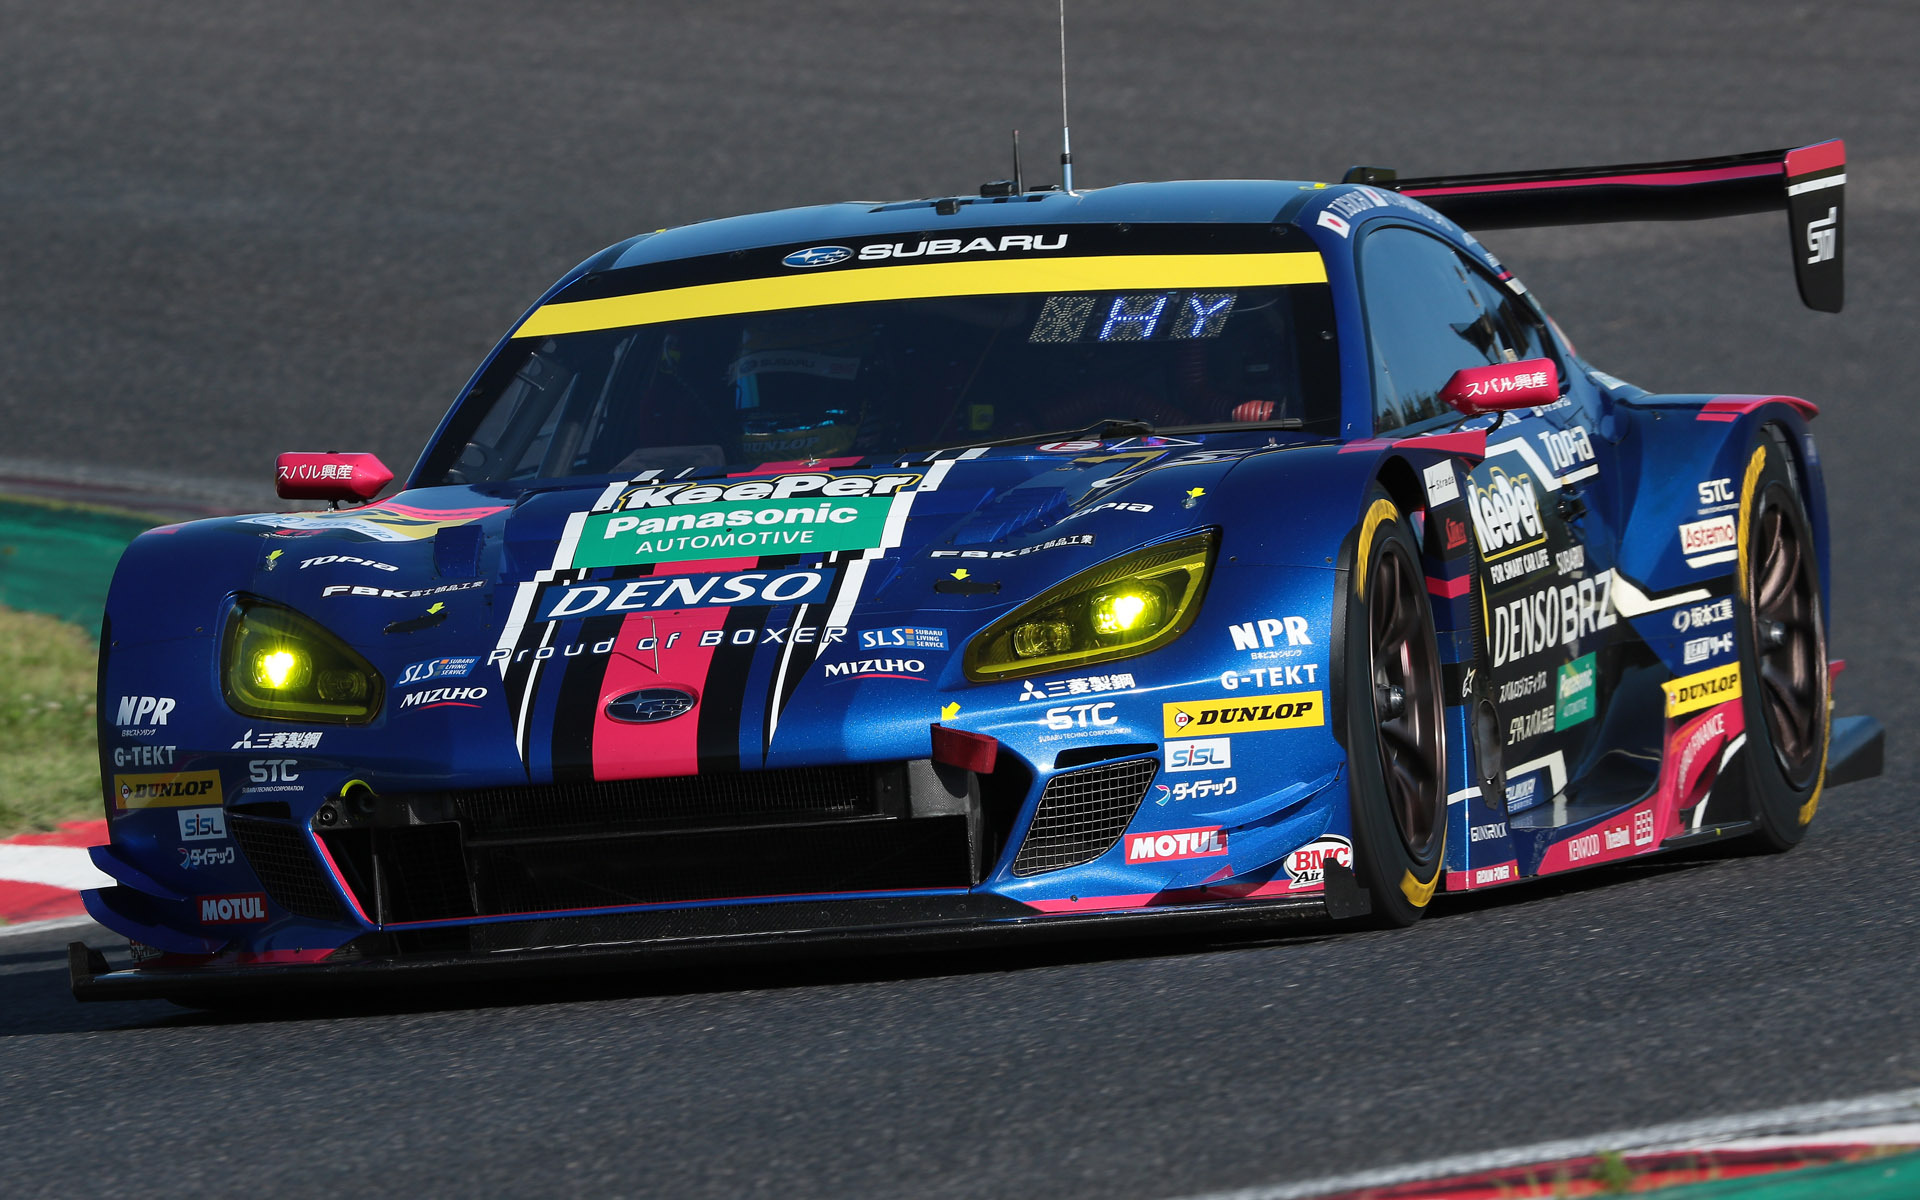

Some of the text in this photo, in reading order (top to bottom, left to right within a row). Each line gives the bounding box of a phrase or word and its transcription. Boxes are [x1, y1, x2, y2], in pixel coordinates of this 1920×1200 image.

[858, 234, 1068, 260] SUBARU
[1466, 371, 1549, 397] スバル興産
[278, 464, 354, 480] スバル興産
[624, 475, 914, 510] KeePer
[1698, 478, 1735, 504] STC
[603, 503, 859, 540] Panasonic
[1467, 474, 1543, 554] KeePer
[635, 530, 815, 554] AUTOMOTIVE
[1686, 521, 1734, 549] Astemo
[931, 549, 1018, 560] FBK
[1490, 564, 1505, 584] FOR
[321, 586, 411, 598] FBK
[547, 572, 822, 618] DENSO
[1493, 569, 1618, 668] DENSO BRZ
[487, 626, 849, 665] Proud of BOXER
[862, 627, 905, 648] SLS
[915, 629, 943, 637] SUBARU
[915, 640, 945, 648] SERVICE
[1228, 616, 1314, 651] NPR
[399, 660, 441, 686] SLS
[825, 659, 926, 678] MIZUHO
[1220, 664, 1318, 691] G-TEKT
[400, 687, 488, 709] MIZUHO
[1044, 672, 1137, 699] 三菱製鋼
[1678, 673, 1738, 703] DUNLOP
[116, 696, 176, 726] NPR
[1046, 702, 1119, 731] STC
[1196, 701, 1314, 726] DUNLOP
[252, 731, 323, 749] 三菱製鋼
[1063, 731, 1089, 740] TECHNO
[114, 746, 176, 767] G-TEKT
[249, 760, 300, 783] STC
[134, 780, 214, 799] DUNLOP
[1172, 777, 1237, 801] ダイテック
[190, 846, 235, 866] ダイテック
[1129, 829, 1224, 861] MOTUL
[1567, 832, 1600, 862] KENWOOD
[1294, 846, 1350, 873] BMC
[1294, 871, 1322, 884] Air
[201, 897, 265, 922] MOTUL
